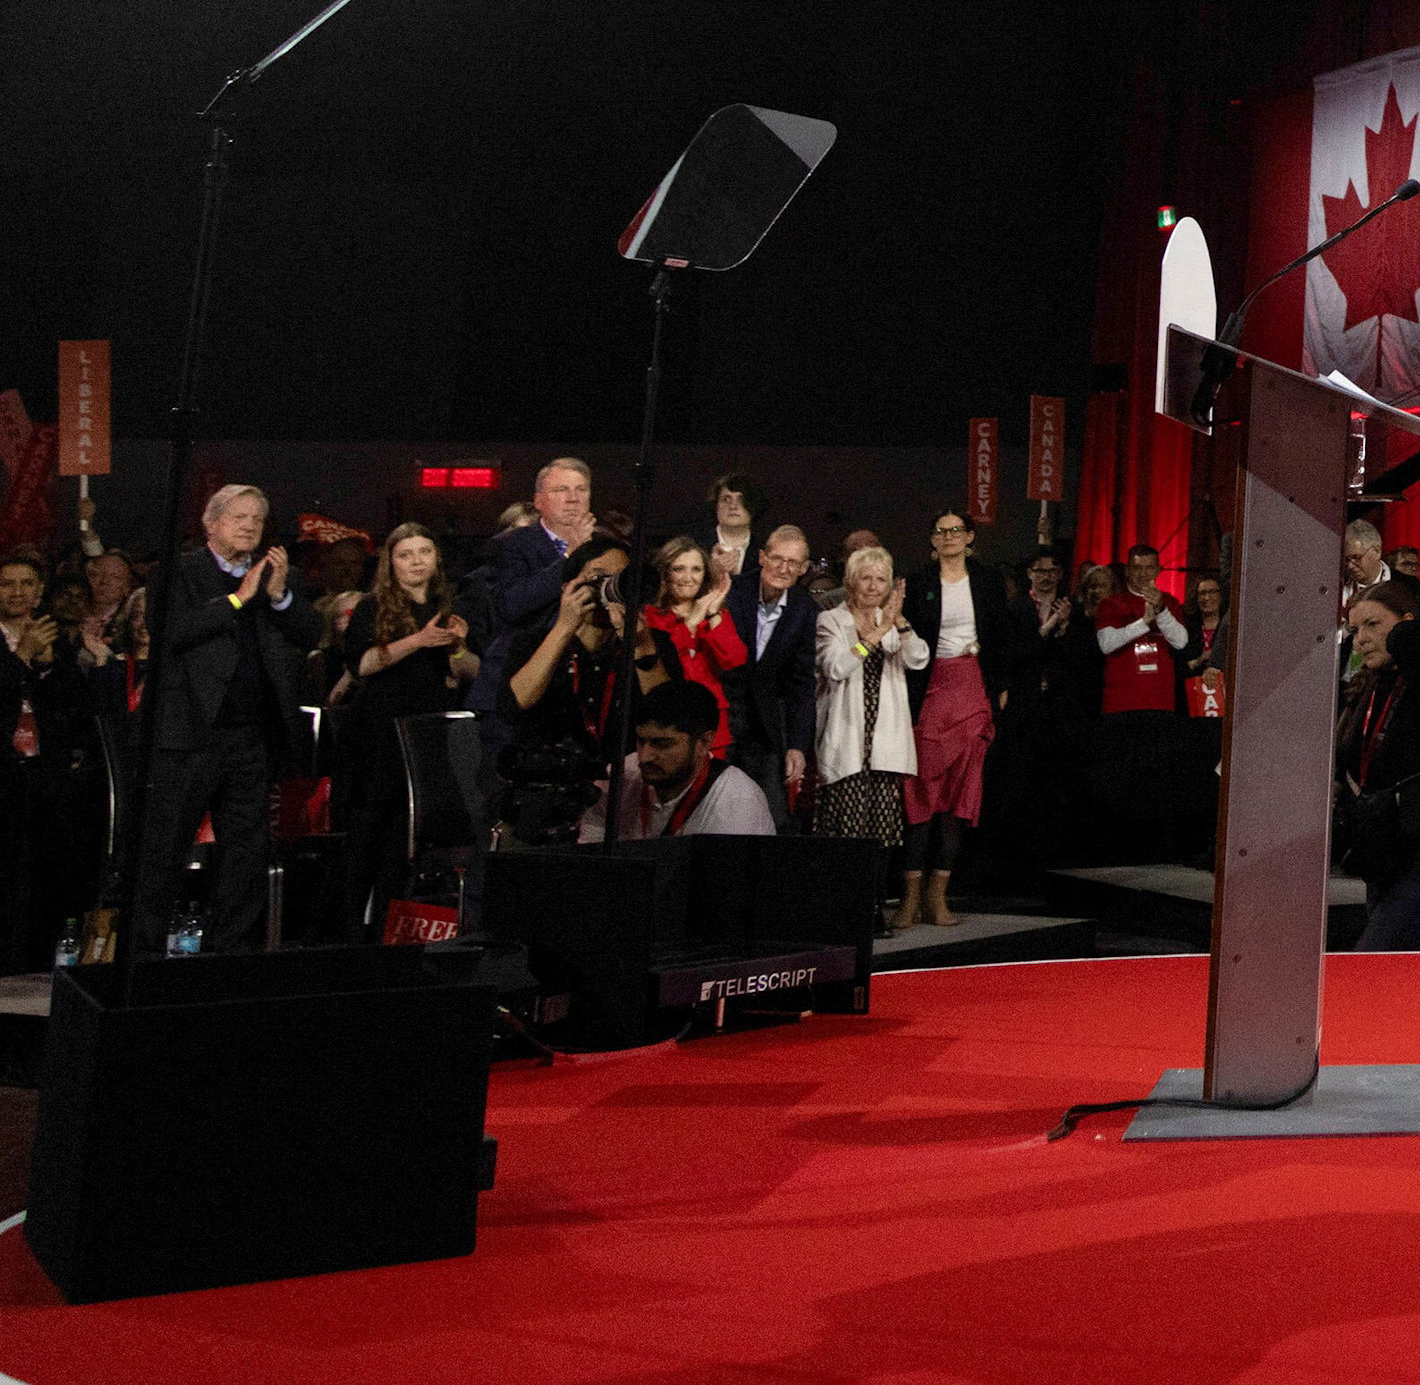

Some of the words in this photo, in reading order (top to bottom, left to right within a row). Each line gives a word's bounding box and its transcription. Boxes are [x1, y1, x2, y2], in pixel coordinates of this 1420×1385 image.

[78, 349, 93, 465] LIBERAL
[1039, 404, 1055, 494] CANADA
[976, 422, 991, 515] CARNEY
[716, 967, 818, 997] TELESCRIPT
